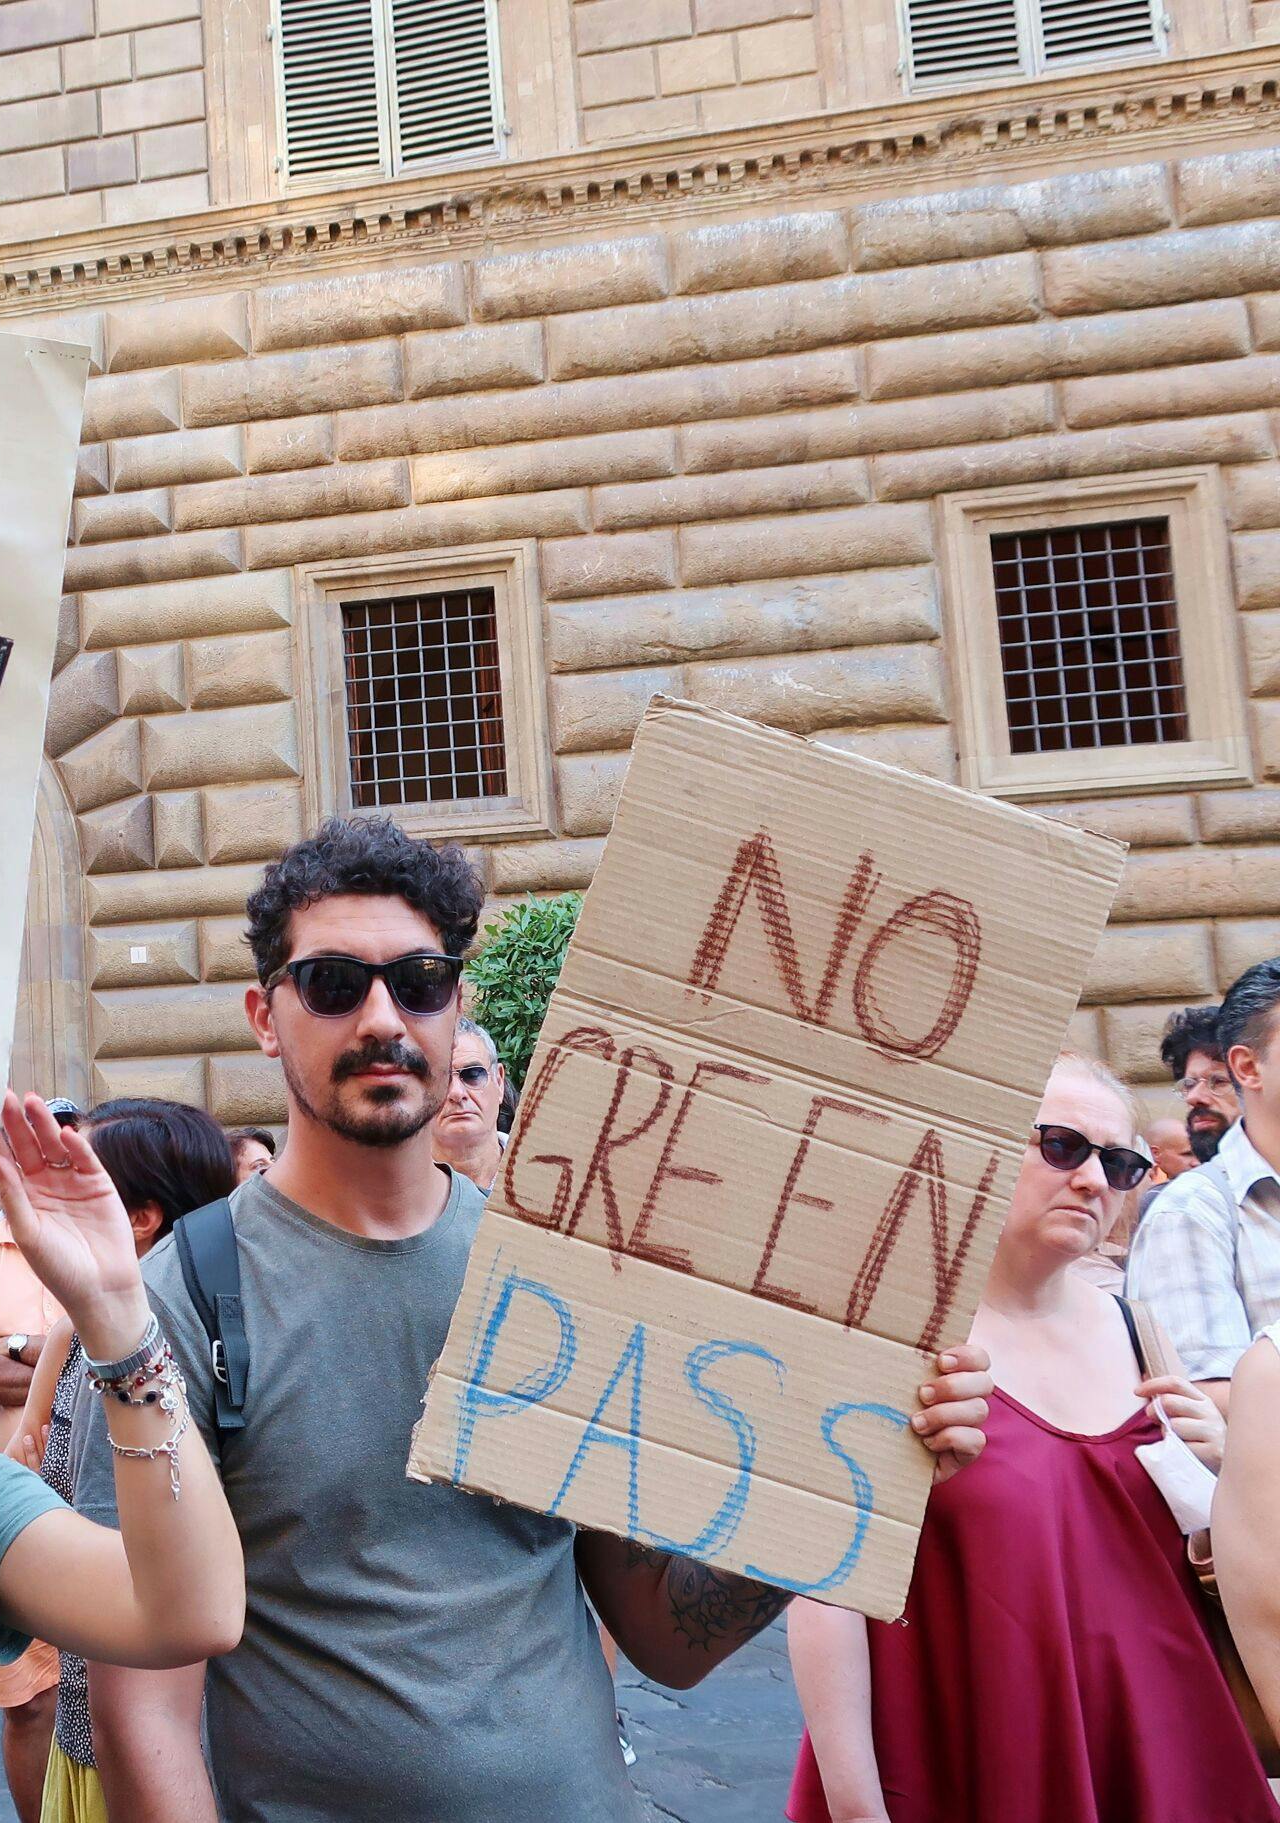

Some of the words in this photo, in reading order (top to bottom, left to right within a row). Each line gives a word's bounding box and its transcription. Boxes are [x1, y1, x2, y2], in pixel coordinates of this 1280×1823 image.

[686, 826, 983, 1062] NO
[504, 1027, 1001, 1360] GREEN
[451, 1248, 912, 1594] PASS
